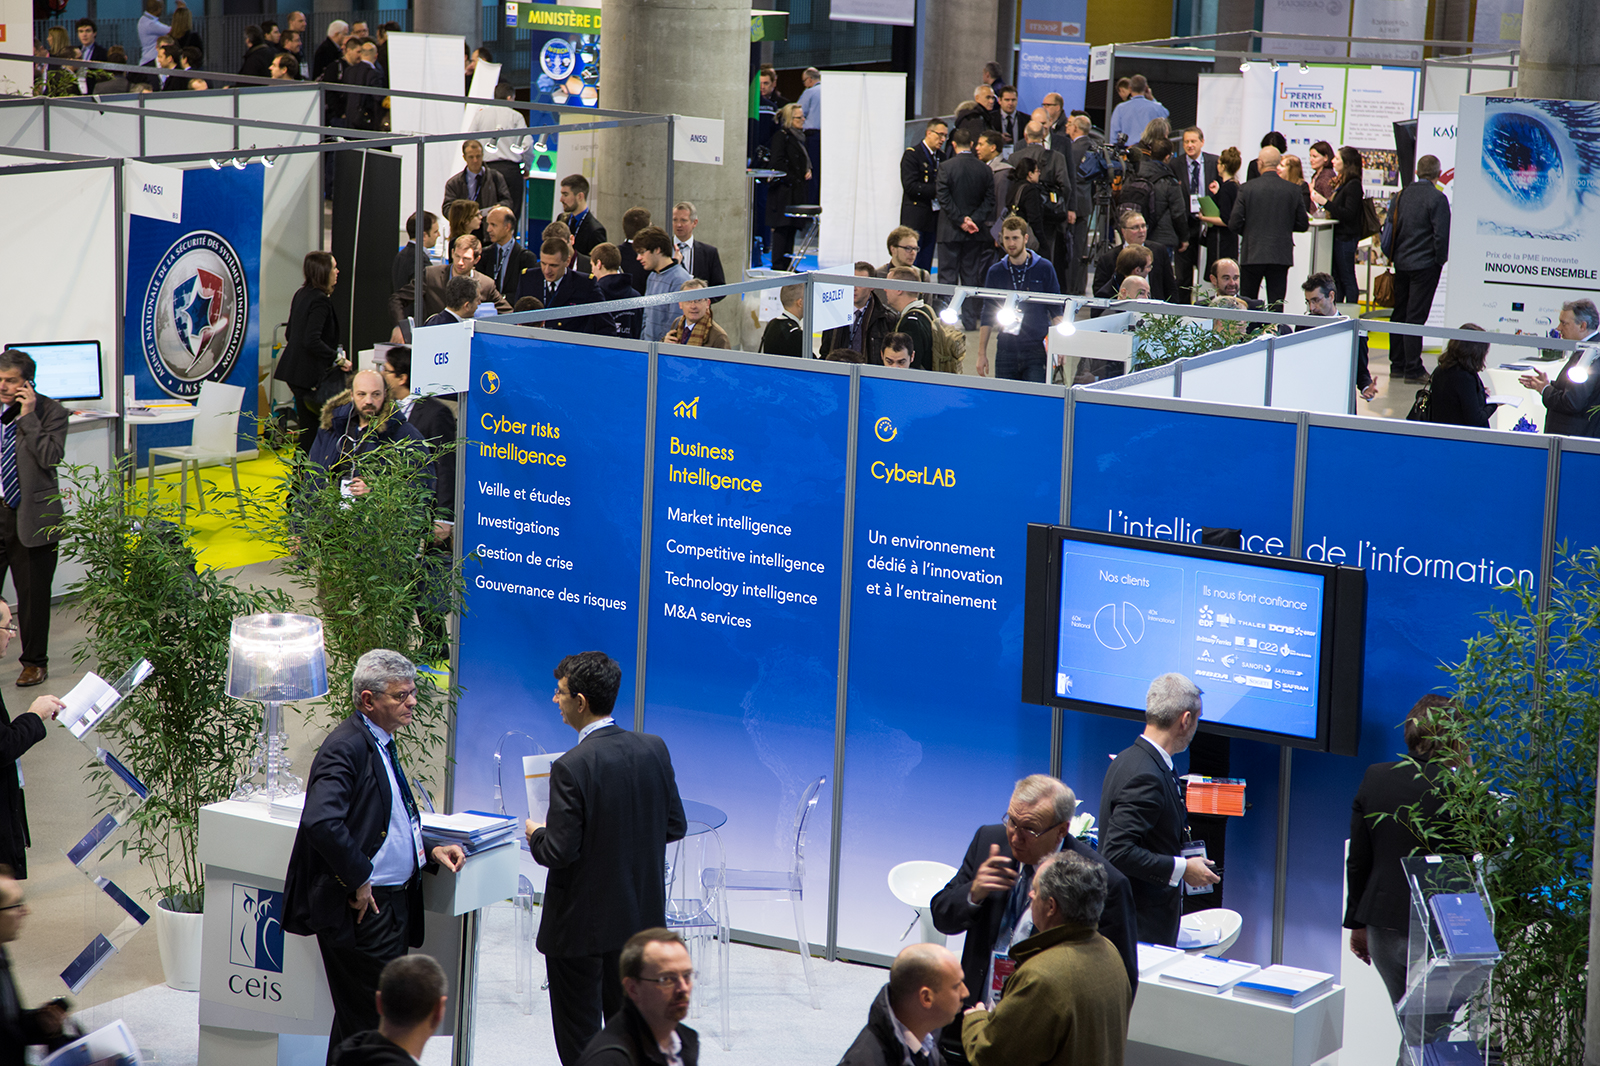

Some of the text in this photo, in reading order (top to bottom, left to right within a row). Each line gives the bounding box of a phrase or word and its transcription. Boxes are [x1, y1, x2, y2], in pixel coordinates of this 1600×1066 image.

[528, 10, 591, 28] MINISTÈRE
[1022, 53, 1044, 63] Centre
[1055, 56, 1088, 65] recherche
[1290, 92, 1322, 100] PERMIS
[1290, 101, 1333, 109] INTERNET
[690, 134, 708, 143] ANSSI
[143, 183, 164, 196] ANSSI
[1486, 251, 1500, 259] Prix
[1541, 254, 1579, 264] innovante
[1485, 262, 1598, 279] INNOVONS ENSEMBLE
[145, 236, 243, 377] AGENCE NATIONALE DE LA SÉCURITÉ DES SYSTÈMES D'INFORMATION
[822, 288, 845, 303] BEAZLEY
[434, 352, 449, 365] CEIS
[481, 413, 560, 439] Cyber risks
[480, 442, 567, 468] intelligence
[670, 436, 735, 461] Business
[669, 464, 763, 493] Intelligence
[871, 460, 957, 488] CyberLAB
[478, 481, 571, 507] Veille et études
[477, 512, 560, 537] Investigations
[667, 507, 792, 536] Market intelligence
[666, 539, 825, 574] Competitive intelligence
[868, 529, 996, 559] Un environnement
[476, 543, 574, 571] Gestion de crise
[1306, 536, 1347, 564] de
[1358, 540, 1534, 590] l'information
[867, 555, 1003, 586] dédié à l'innovation
[1099, 570, 1150, 587] Nos clients
[475, 575, 627, 611] Gouvernance des risques
[665, 571, 818, 605] Technology intelligence
[866, 582, 997, 610] et à l'entrainement
[1203, 585, 1308, 611] Ils nous font confiance
[664, 603, 752, 628] M&A services
[1071, 621, 1091, 629] National
[1238, 620, 1266, 629] THALES
[1241, 662, 1264, 671] SANOFI
[1282, 682, 1309, 692] SAFRAN
[228, 974, 282, 1002] ceis
